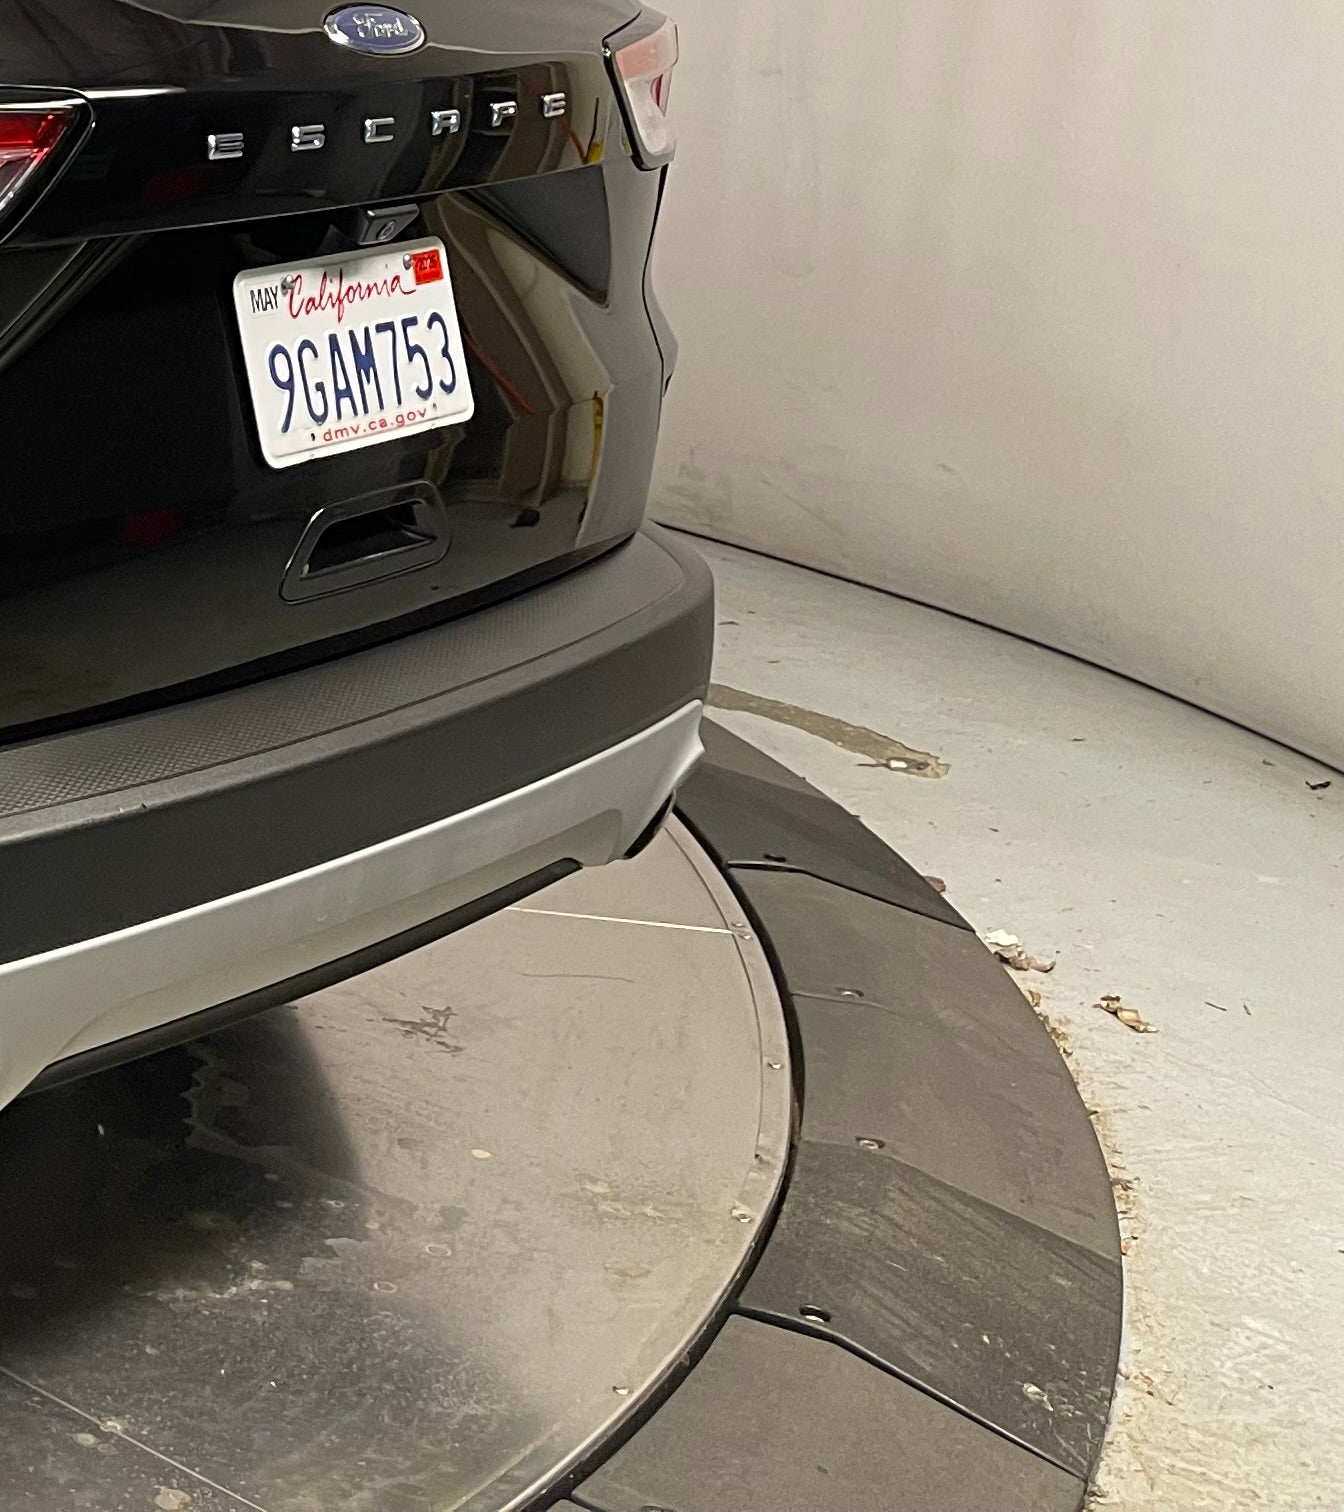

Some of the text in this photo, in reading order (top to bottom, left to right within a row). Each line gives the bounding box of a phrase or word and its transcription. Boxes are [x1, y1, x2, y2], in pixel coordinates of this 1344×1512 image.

[352, 12, 409, 39] Ford
[207, 93, 566, 160] ESCAPE
[249, 284, 280, 315] MAY
[287, 268, 416, 323] California
[268, 311, 457, 434] 9GAM753
[323, 405, 428, 443] dmv.ca.gov
